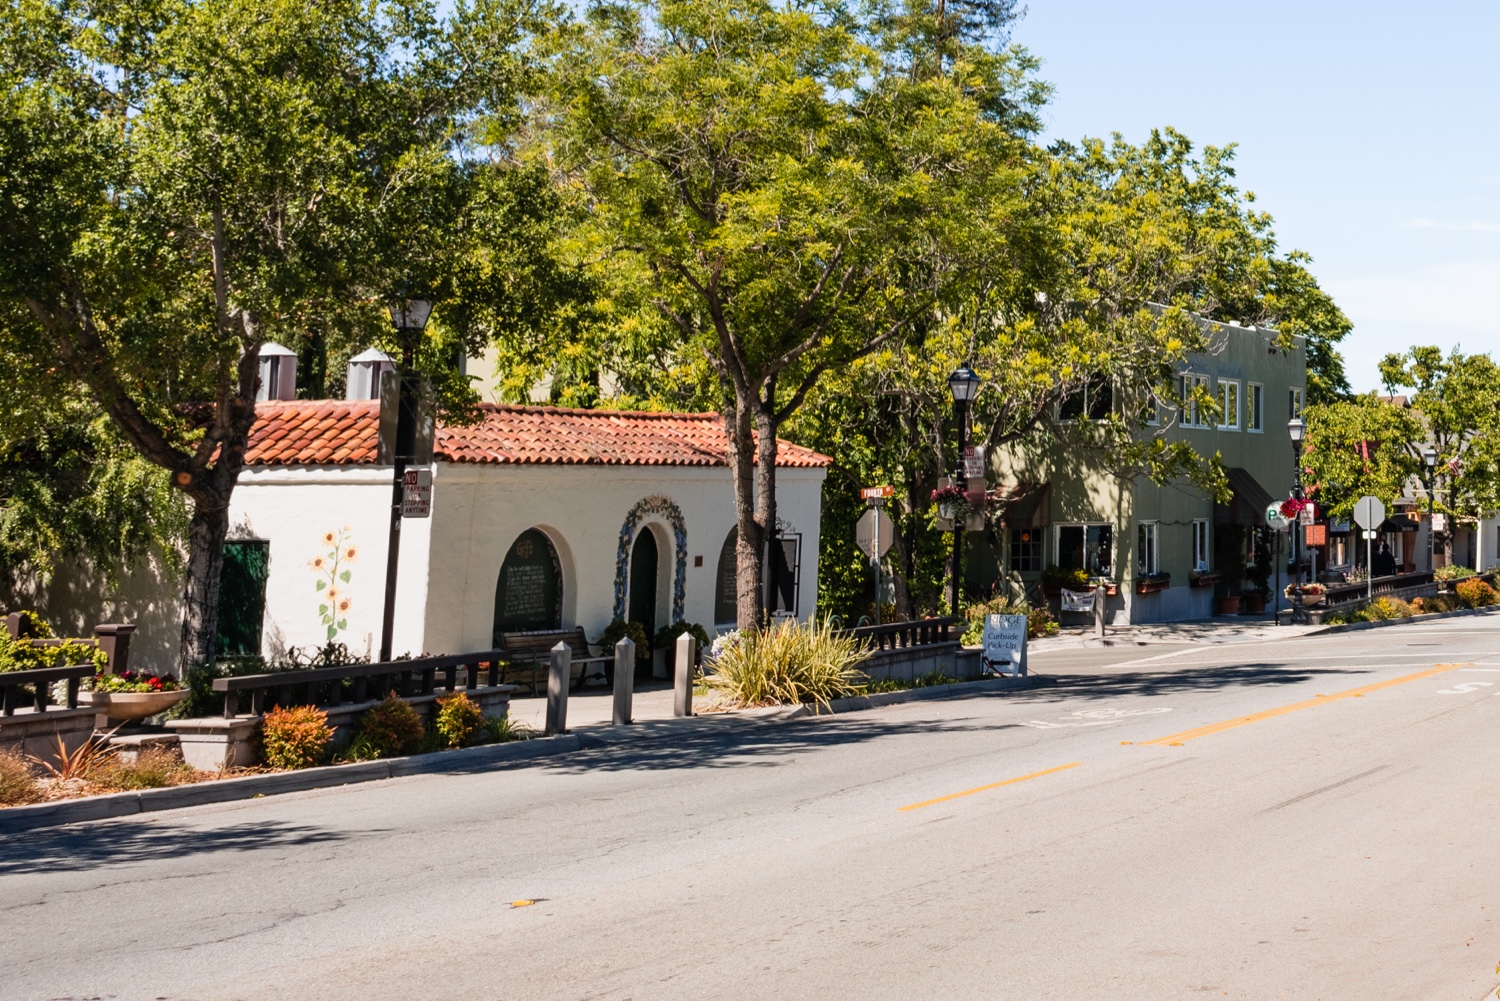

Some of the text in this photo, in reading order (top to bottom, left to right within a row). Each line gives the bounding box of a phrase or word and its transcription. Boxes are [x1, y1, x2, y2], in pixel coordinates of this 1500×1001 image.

[406, 473, 417, 483] NO
[988, 632, 1019, 640] Curbside
[988, 641, 1016, 650] Pick-Up
